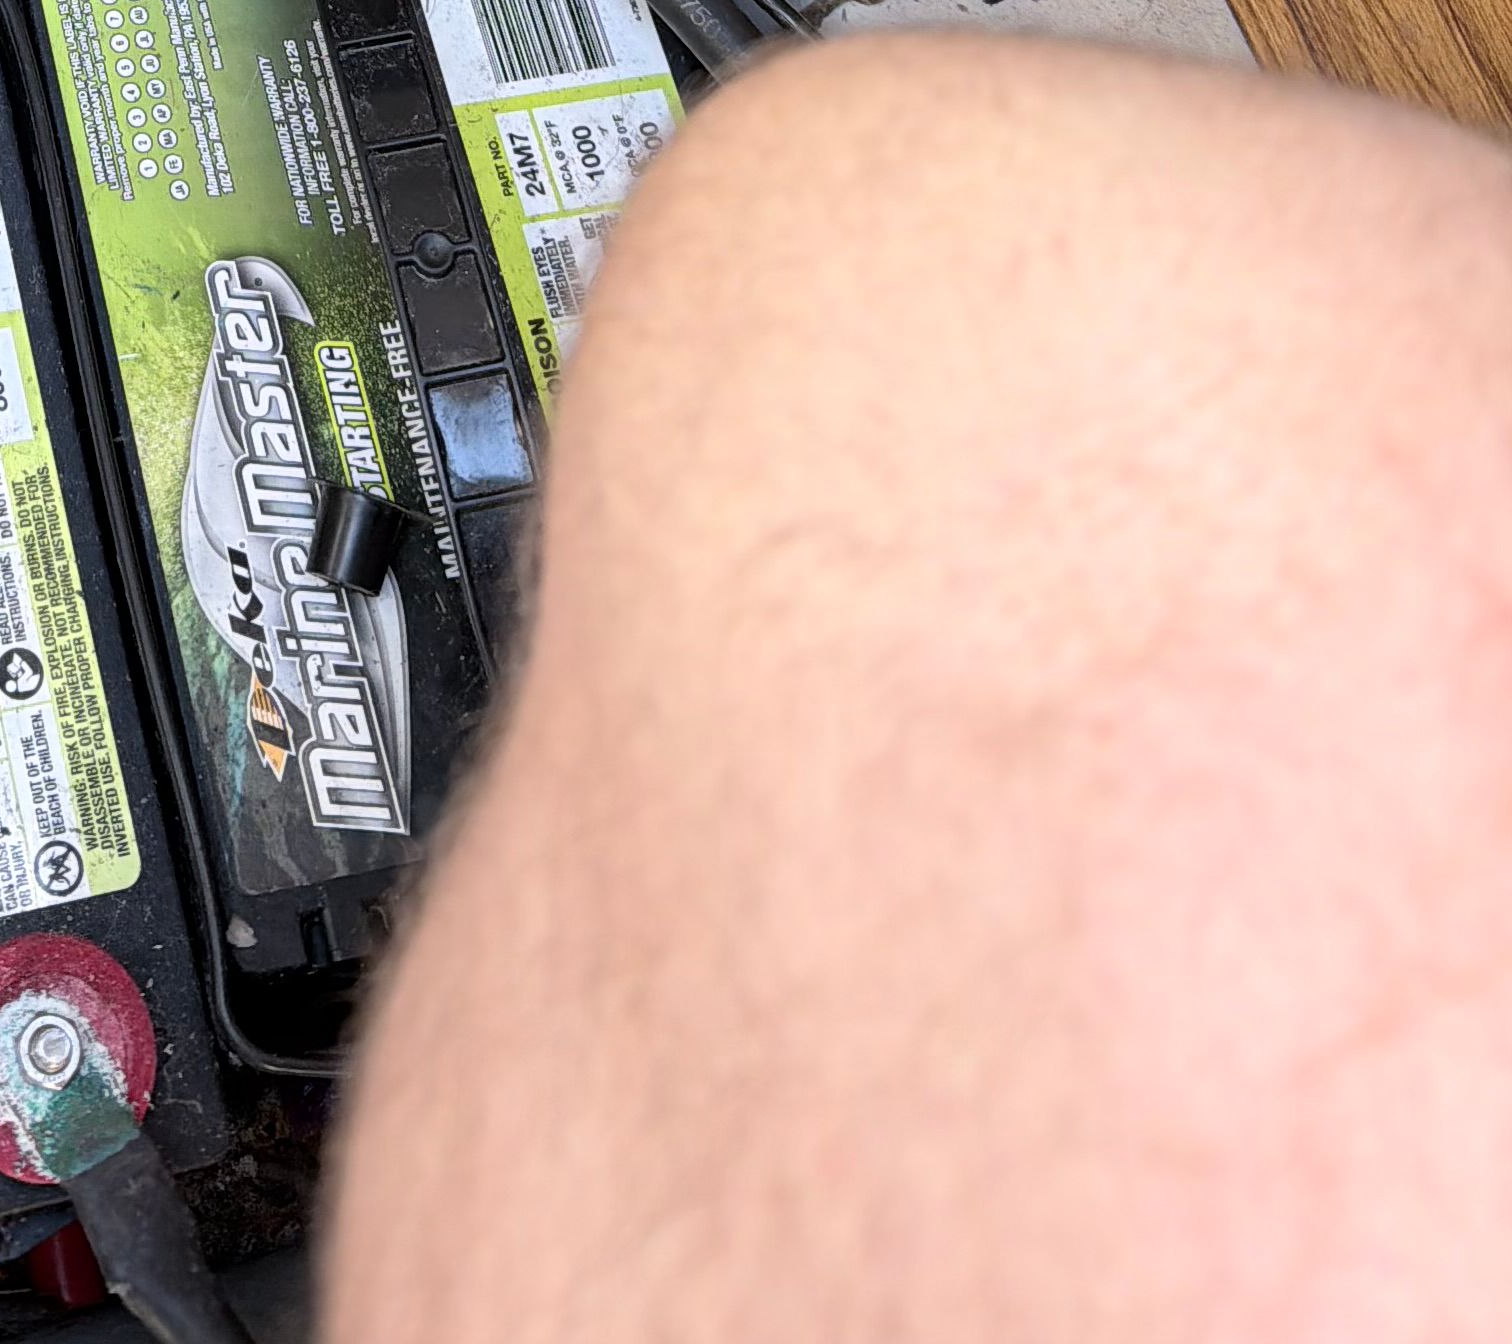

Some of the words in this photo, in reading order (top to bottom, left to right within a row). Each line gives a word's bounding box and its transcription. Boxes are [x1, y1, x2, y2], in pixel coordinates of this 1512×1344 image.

[58, 3, 69, 14] IS
[82, 2, 91, 13] to
[61, 15, 77, 49] LABEL
[84, 14, 97, 36] tabs
[182, 23, 195, 38] PA
[76, 30, 90, 52] only
[91, 38, 104, 60] year
[69, 51, 83, 76] THIS
[81, 53, 94, 77] valid
[95, 62, 107, 82] and
[173, 46, 190, 74] Penn
[75, 78, 85, 88] IF
[180, 74, 196, 99] East
[197, 80, 214, 107] Lyon
[77, 90, 92, 118] VOID
[87, 79, 108, 141] WARRANTY
[100, 84, 115, 117] month
[108, 118, 125, 154] proper
[487, 136, 502, 160] NO.
[84, 119, 106, 183] WARRANTY
[190, 118, 220, 196] Manufactured
[211, 141, 228, 171] Deka
[508, 129, 545, 198] 24M7
[570, 123, 606, 182] 1000
[100, 143, 119, 189] LIMITED
[115, 156, 133, 200] Remove
[495, 161, 513, 197] PART
[219, 172, 234, 193] 102
[530, 245, 550, 277] EYES
[541, 279, 563, 318] FLUSH
[212, 267, 320, 532] Master
[11, 478, 28, 506] NOT
[24, 474, 41, 501] FOR
[16, 508, 32, 527] DO
[36, 461, 67, 561] INSTRUCTIONS.
[21, 529, 43, 579] BURNS.
[30, 502, 62, 607] RECOMMENDED
[31, 581, 47, 602] OR
[57, 563, 83, 633] CHARGING
[52, 610, 69, 637] NOT
[36, 604, 64, 680] EXPLOSION
[72, 636, 95, 690] PROPER
[280, 546, 392, 820] Marine
[60, 719, 76, 738] OF
[84, 692, 107, 750] FOLLOW
[20, 735, 35, 759] THE
[30, 709, 53, 773] CHILDREN.
[77, 726, 93, 746] OR
[26, 760, 40, 777] OF
[65, 741, 83, 775] RISK
[29, 779, 45, 804] OUT
[43, 774, 57, 791] OF
[72, 776, 99, 851] WARNING:
[82, 749, 114, 850] DISASSEMBLE
[35, 806, 51, 838] KEEP
[104, 786, 130, 857] INVERTED
[2, 883, 18, 910] CAN
[18, 886, 33, 907] OR
